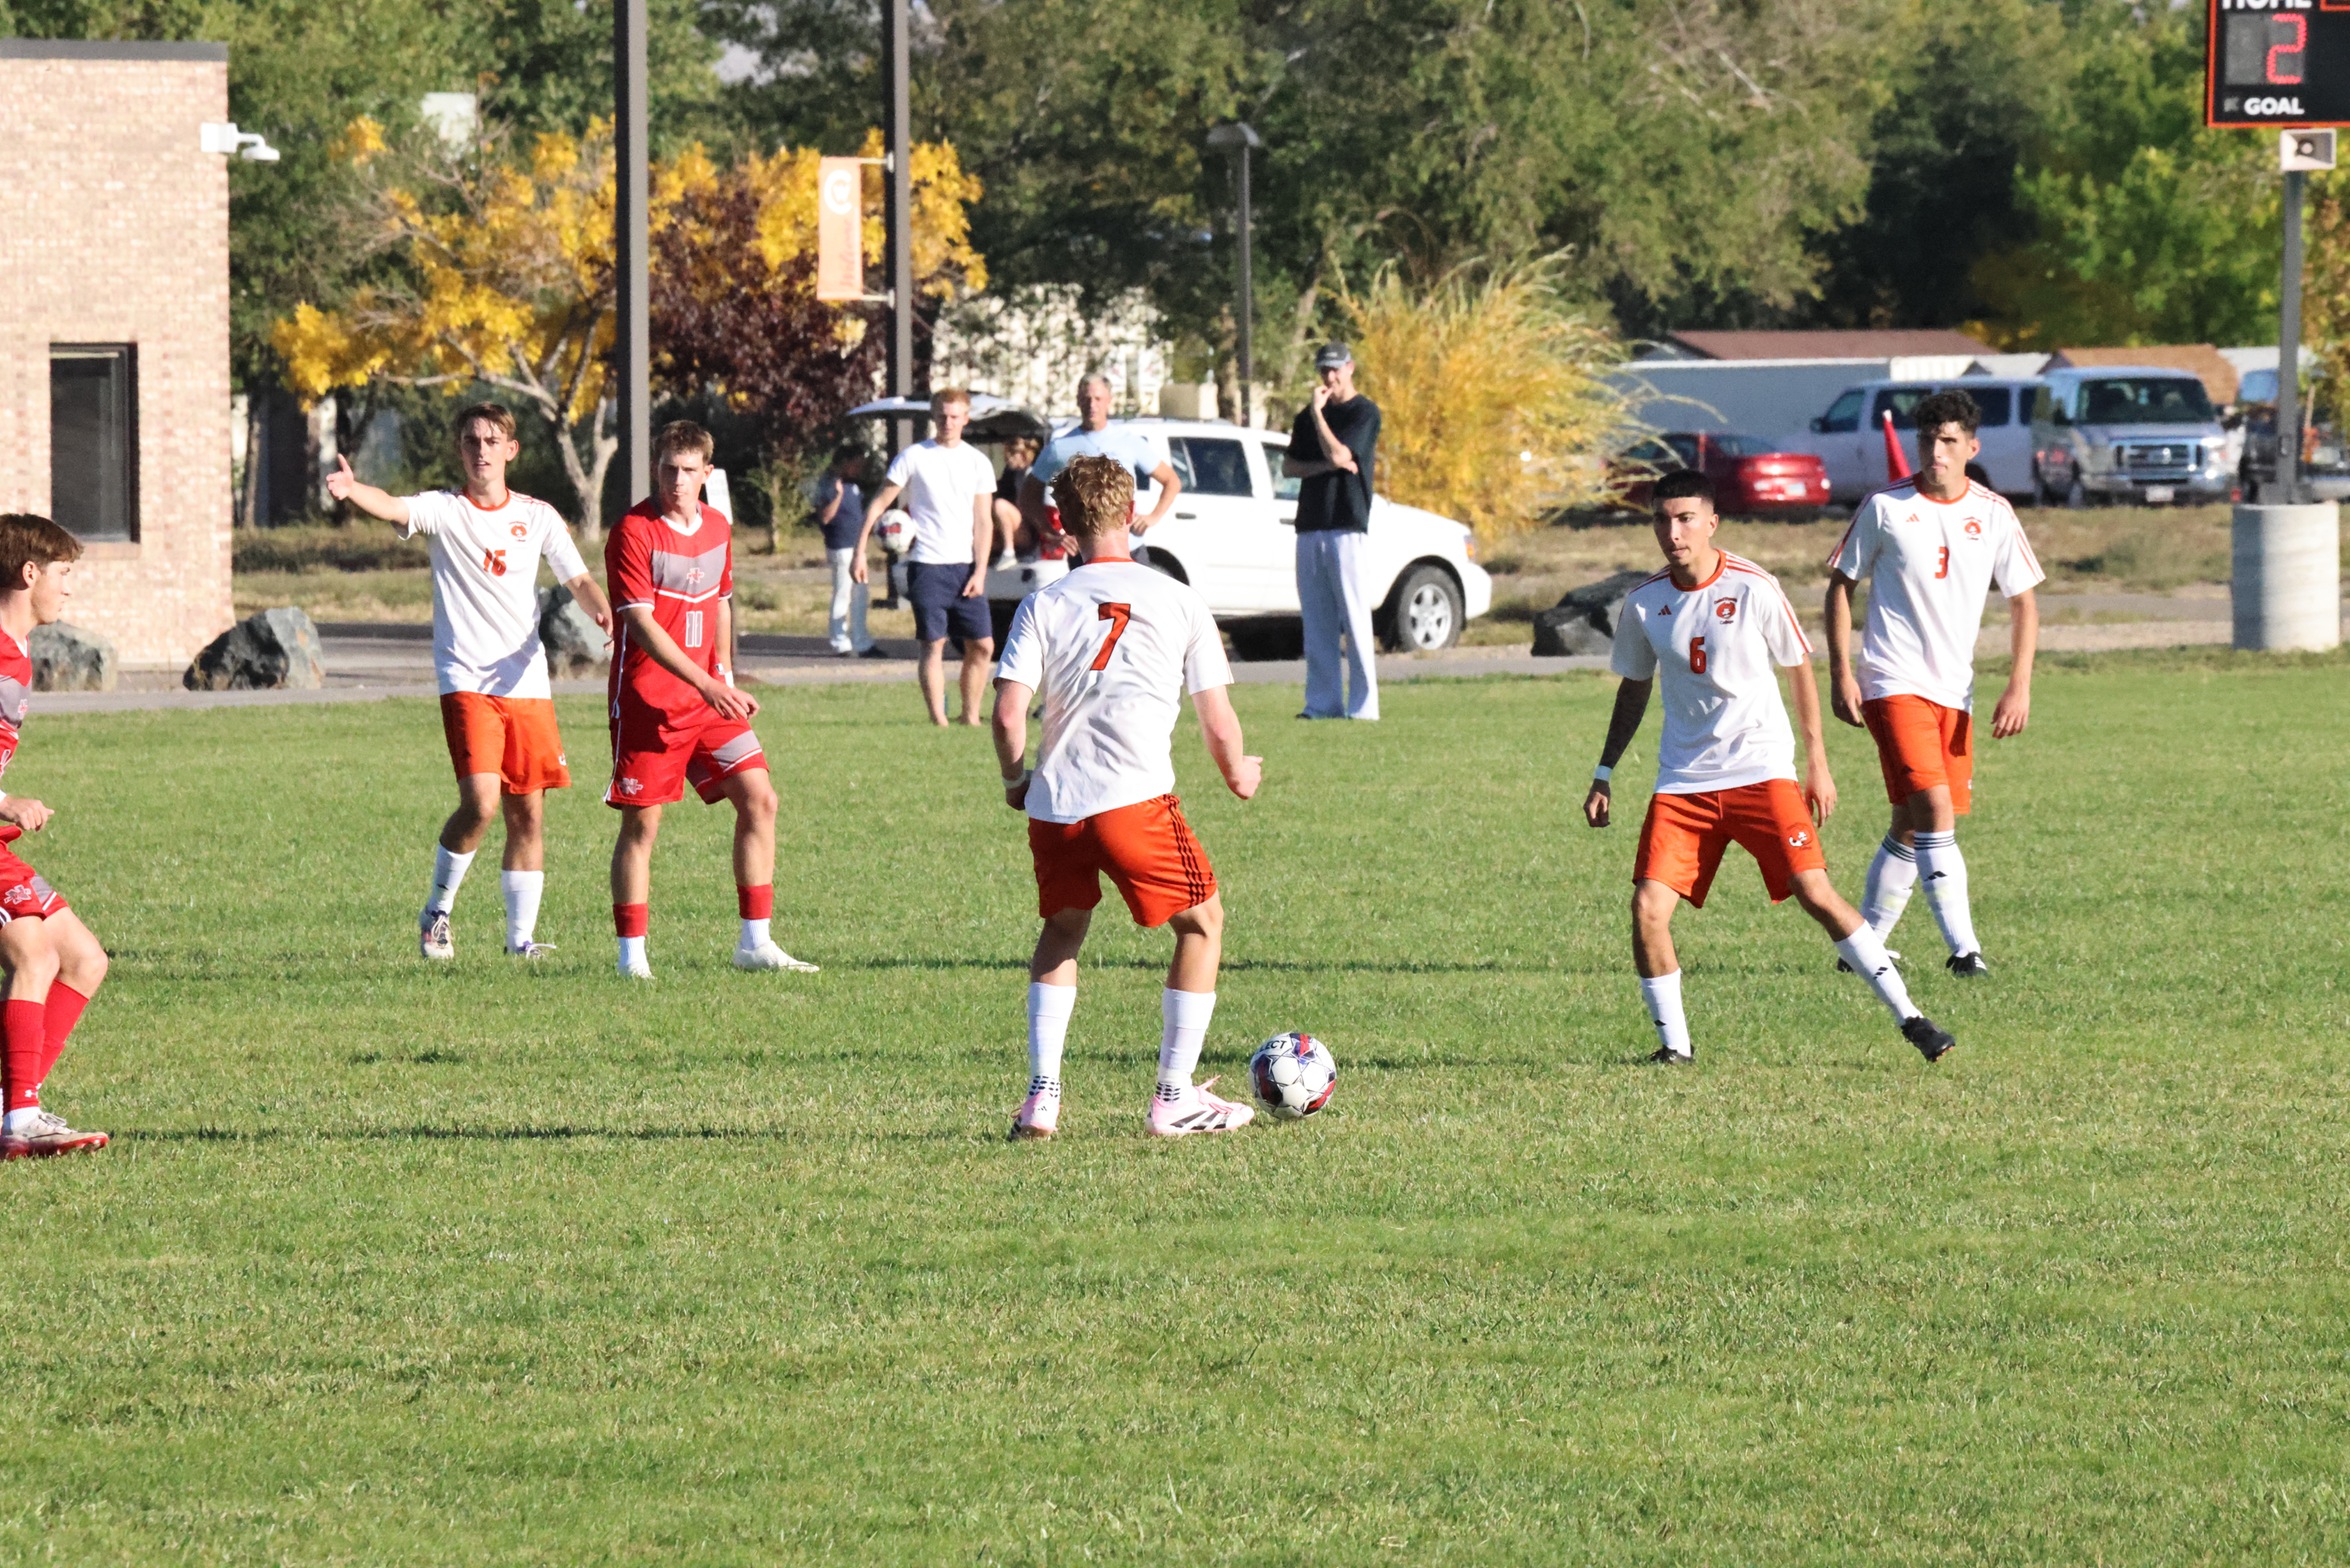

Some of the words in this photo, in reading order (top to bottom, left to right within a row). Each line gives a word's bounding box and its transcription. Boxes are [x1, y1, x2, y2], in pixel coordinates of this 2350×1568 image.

[2266, 13, 2307, 85] 2
[2244, 97, 2305, 116] GOAL
[1934, 546, 1949, 579] 3
[685, 610, 703, 648] 11
[1089, 602, 1131, 671] 7
[1689, 636, 1706, 674] 6
